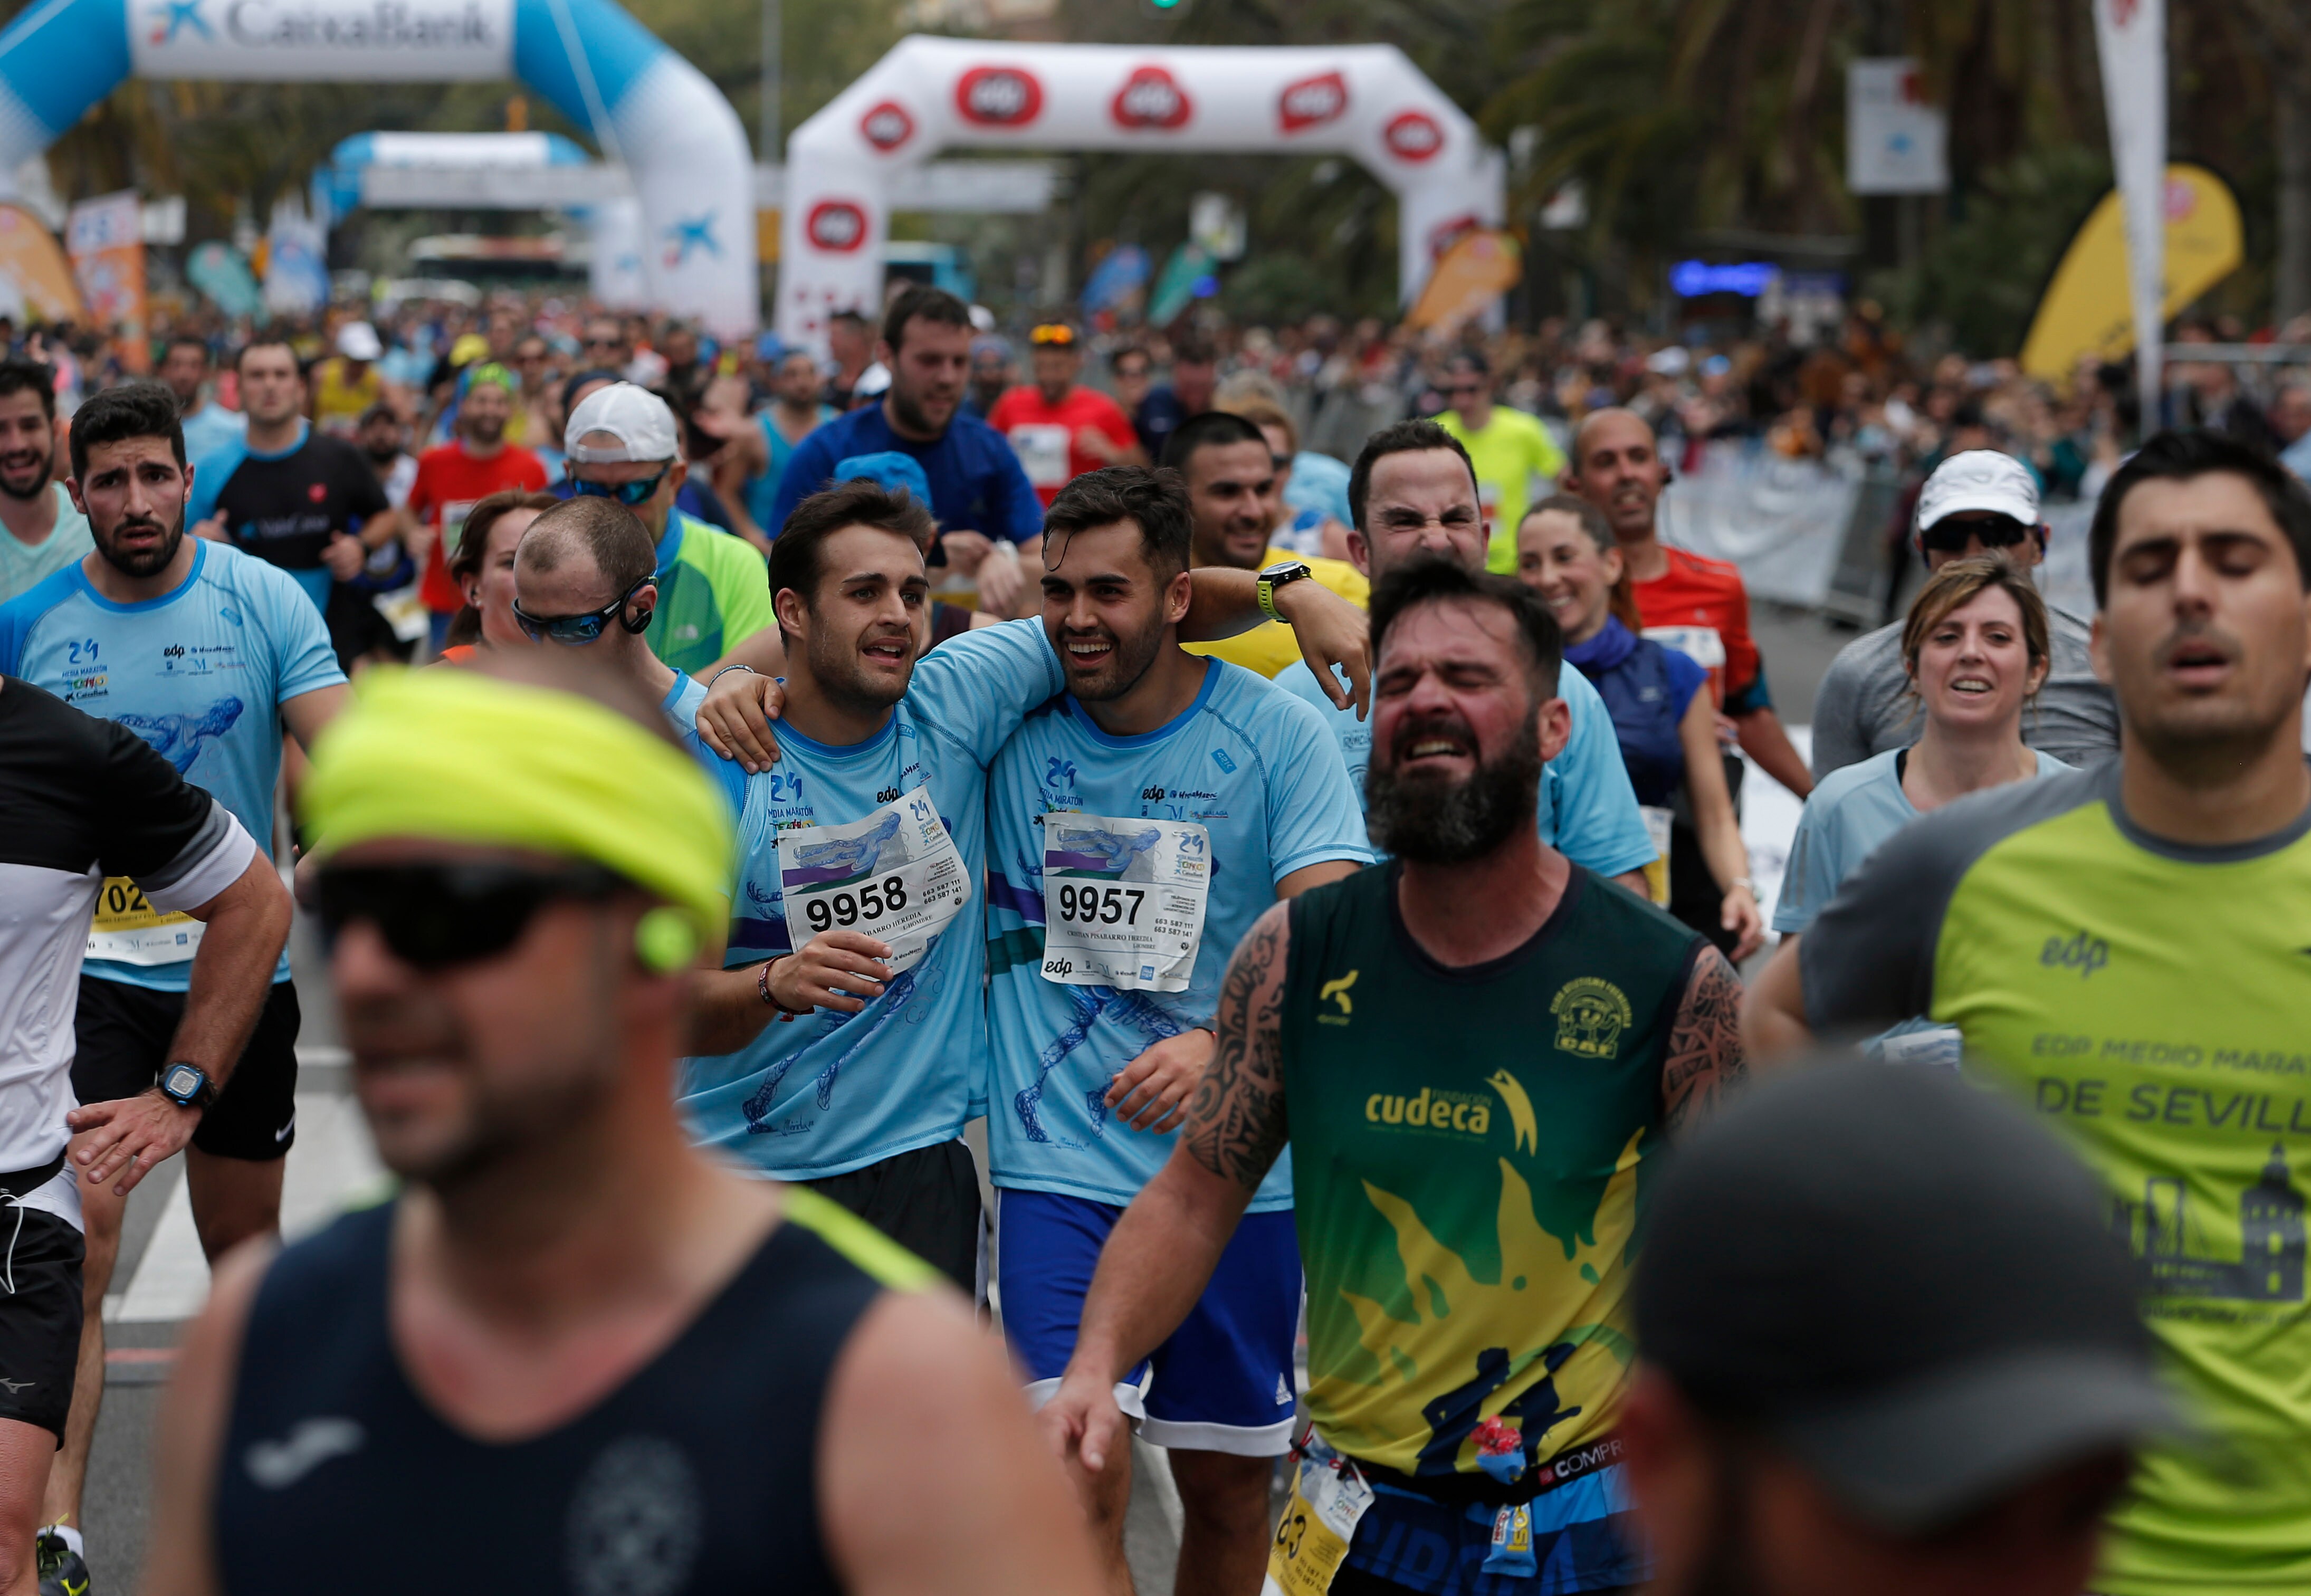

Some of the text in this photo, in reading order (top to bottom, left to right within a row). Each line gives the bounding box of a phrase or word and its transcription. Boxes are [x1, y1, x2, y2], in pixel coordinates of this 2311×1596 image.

[164, 643, 185, 659] edp
[876, 786, 899, 803] edp
[1141, 785, 1164, 804] edp
[923, 888, 934, 897] 663
[937, 883, 949, 891] 587
[924, 886, 961, 904] 663 587 141
[806, 876, 908, 932] 9958
[1060, 885, 1144, 925] 9957
[863, 911, 922, 936] ABARRO HEREDIA
[1067, 930, 1089, 939] CRISTIAN
[2040, 929, 2110, 979] edp
[1044, 958, 1072, 978] edp
[1560, 1036, 1613, 1056] CAF
[2031, 1032, 2311, 1077] EDP MEDIO MARA
[1365, 1087, 1490, 1134] cudeca
[2035, 1077, 2311, 1136] DE SEVILL
[1555, 1439, 1625, 1478] COMPR
